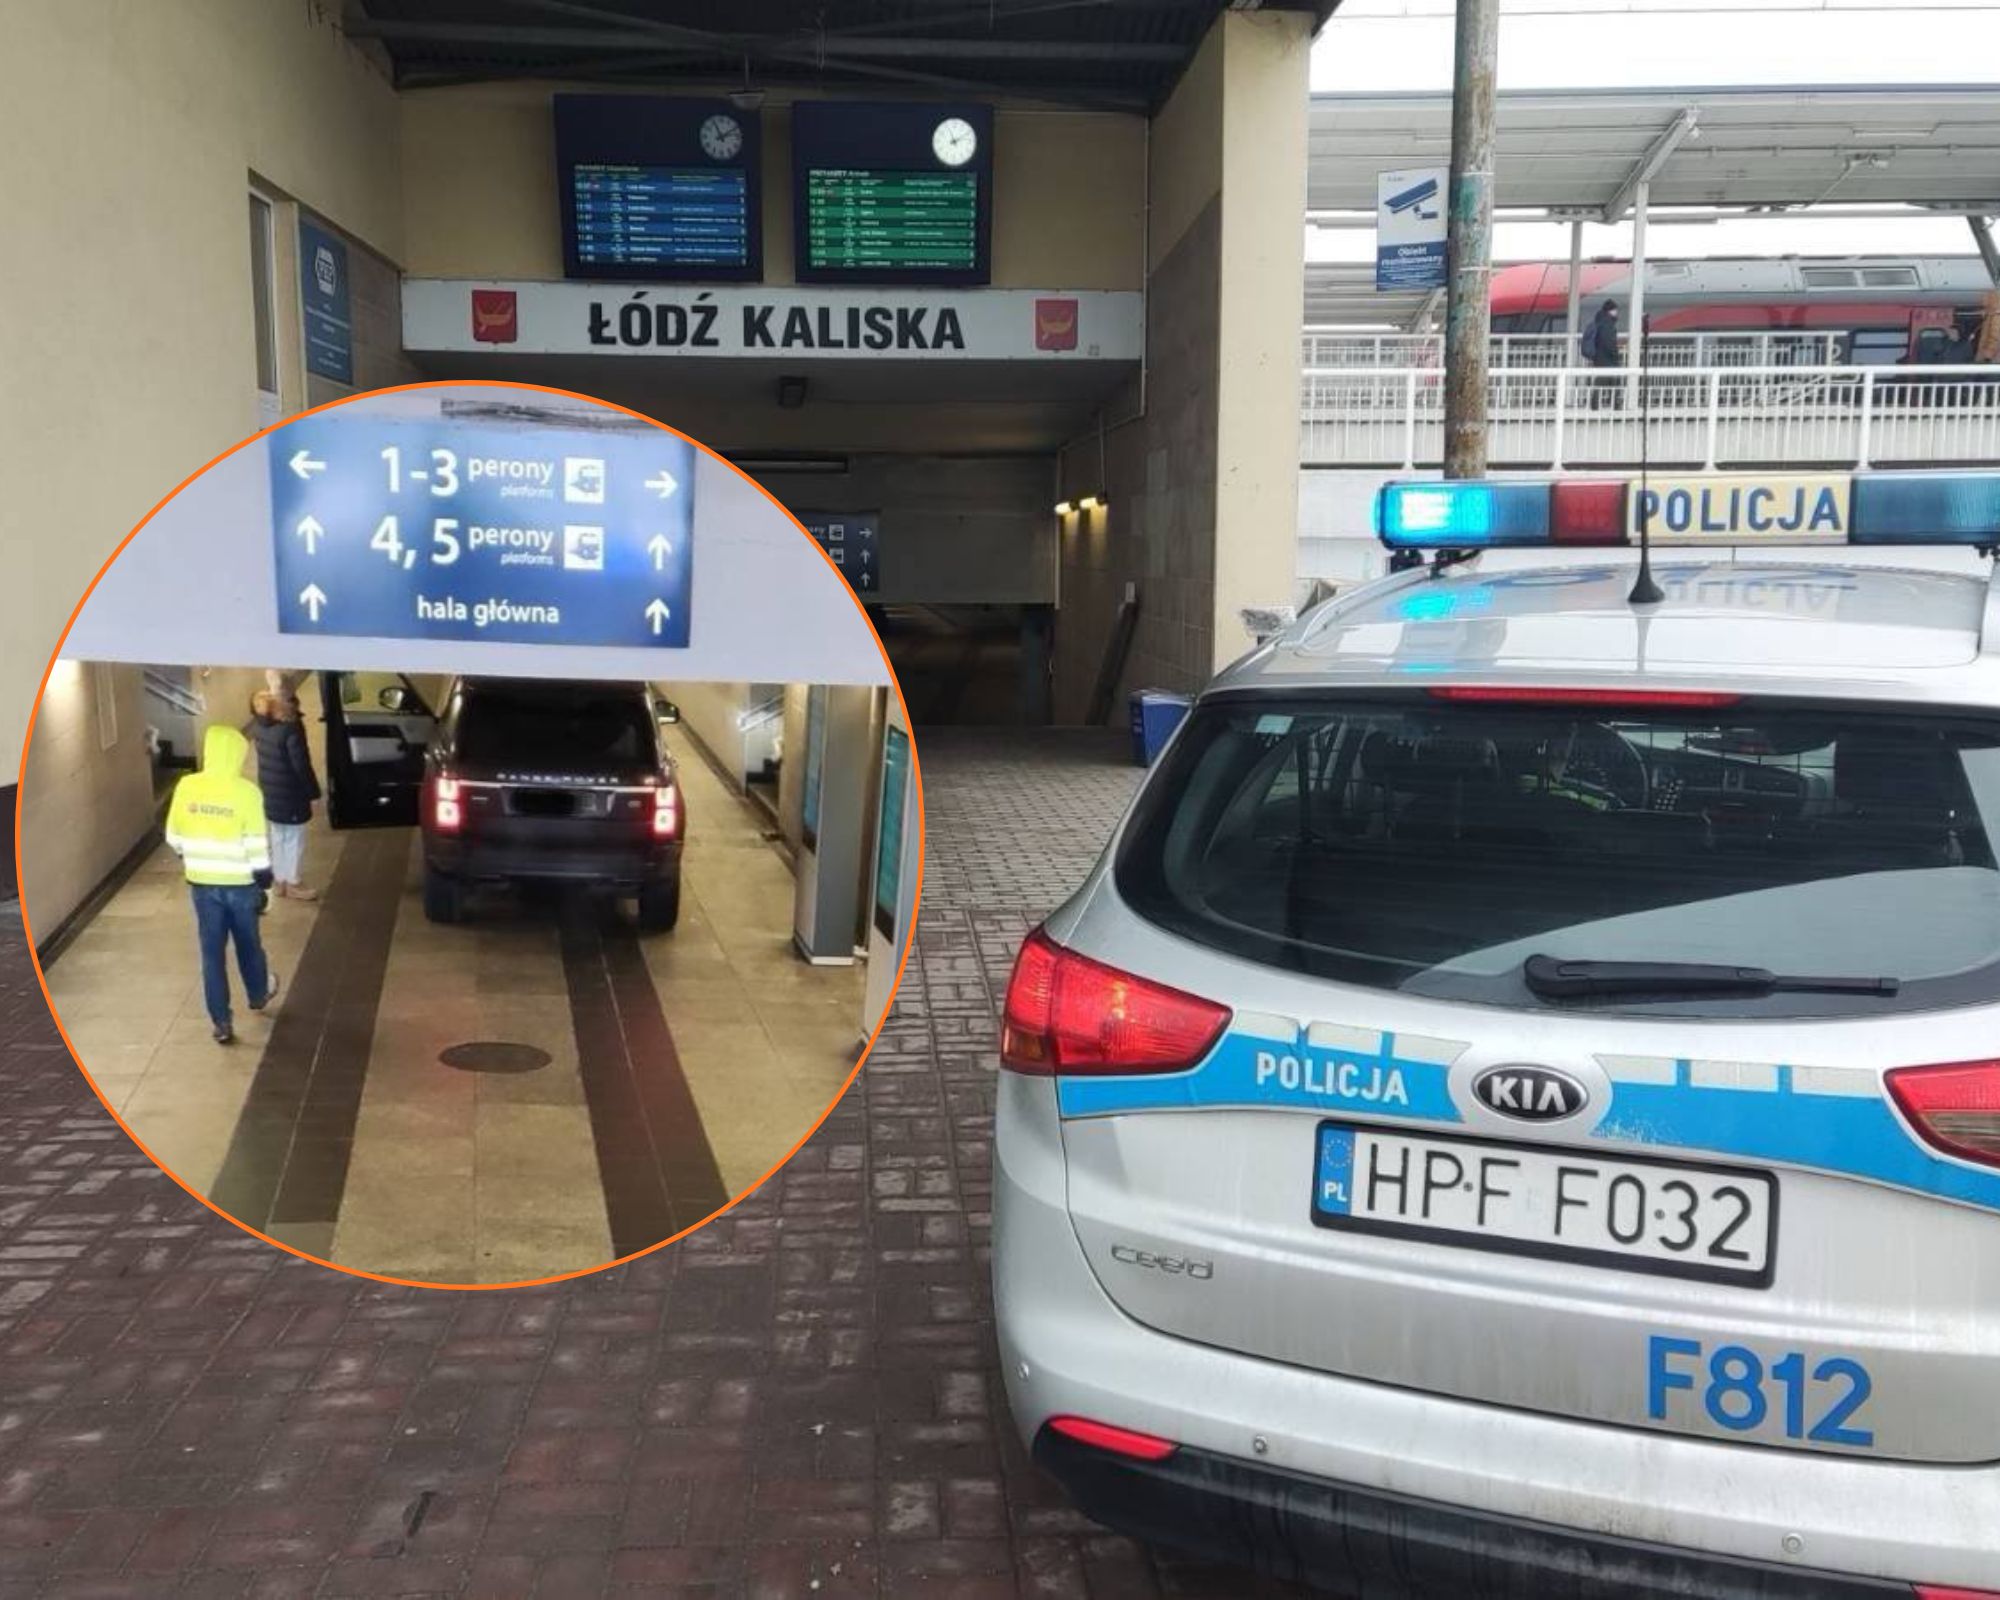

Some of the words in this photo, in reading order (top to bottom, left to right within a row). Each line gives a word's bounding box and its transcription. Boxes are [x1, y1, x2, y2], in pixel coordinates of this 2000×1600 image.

[588, 291, 719, 347] ŁÓDŹ
[743, 305, 965, 350] KALISKA
[381, 446, 459, 496] 1-3
[468, 457, 555, 484] perony
[1635, 486, 1843, 532] POLICJA
[431, 518, 461, 565] 5
[468, 526, 555, 552] perony
[500, 551, 554, 566] platforms
[417, 594, 467, 621] hala
[473, 598, 560, 627] główna
[1256, 1051, 1409, 1106] POLICJA
[1491, 1075, 1567, 1113] KIA
[1325, 1181, 1348, 1202] PL
[1367, 1143, 1521, 1226] HPF
[1554, 1166, 1753, 1261] F032
[1648, 1335, 1874, 1446] F812
